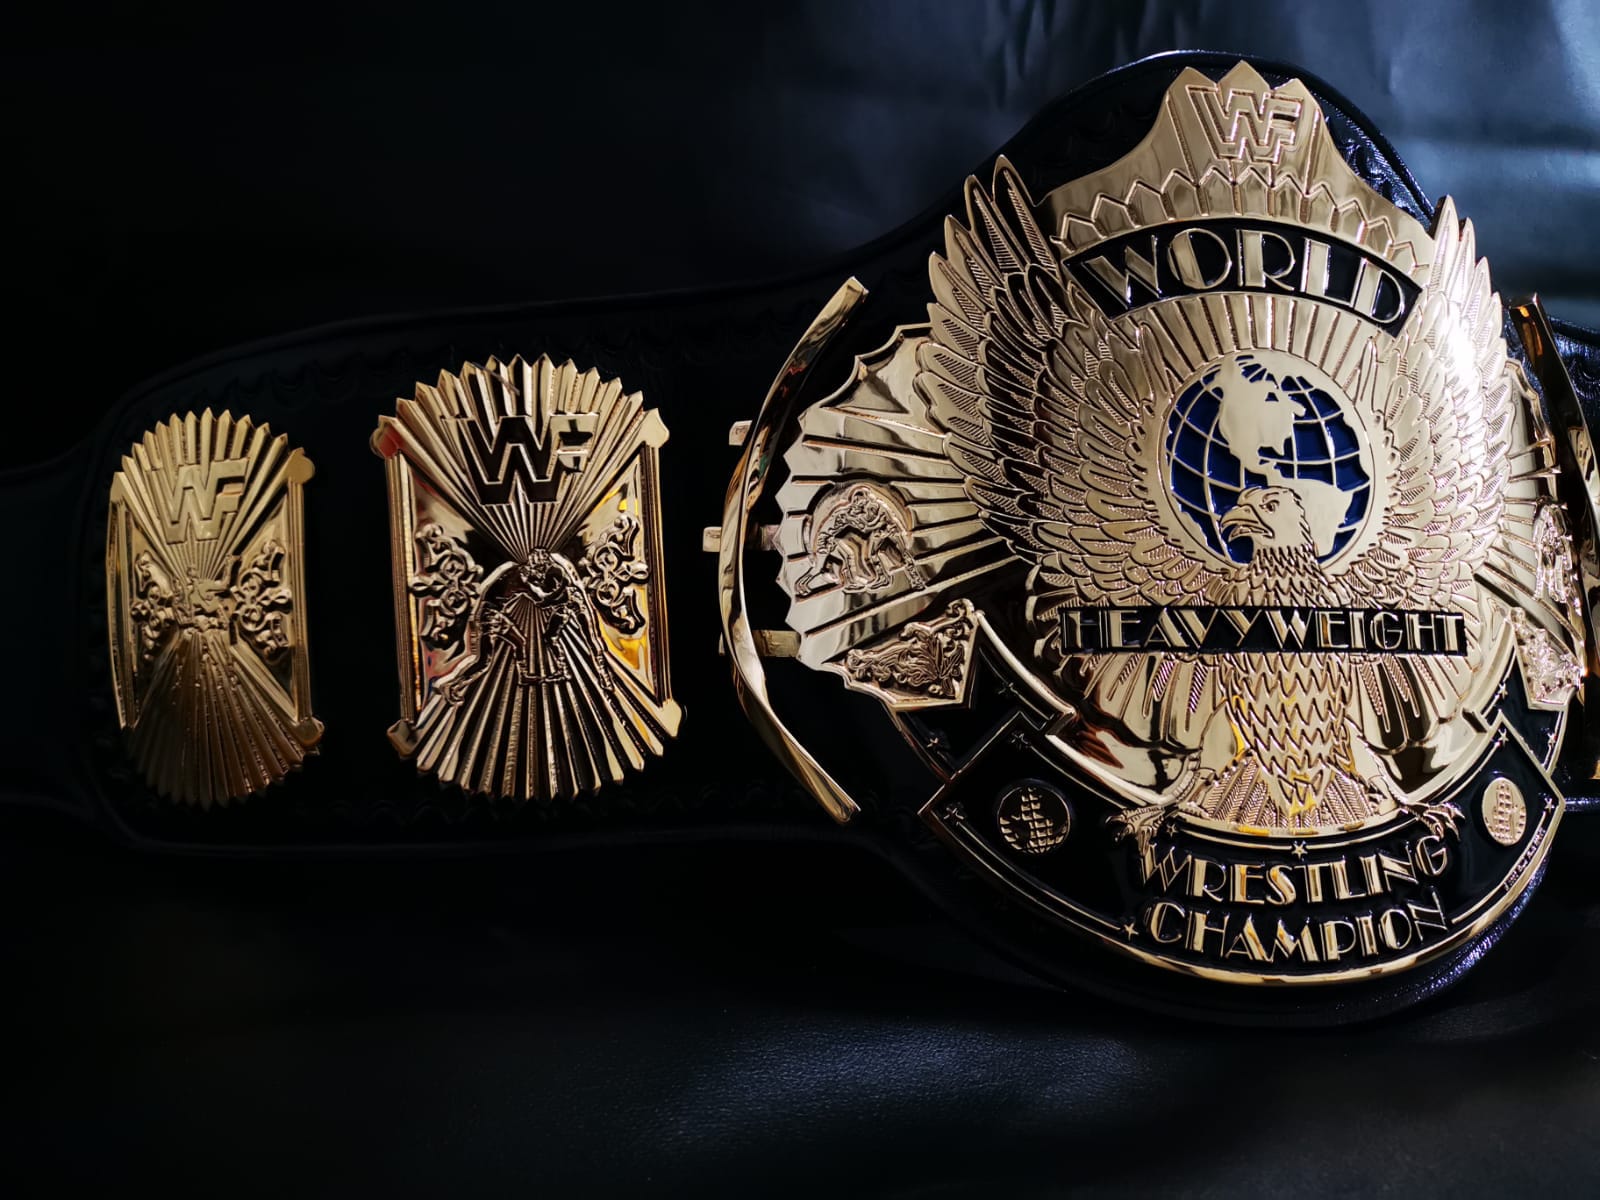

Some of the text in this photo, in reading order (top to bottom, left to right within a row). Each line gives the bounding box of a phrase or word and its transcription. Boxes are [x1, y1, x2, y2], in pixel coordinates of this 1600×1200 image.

[1081, 227, 1405, 324] WORLD
[1064, 609, 1465, 655] HEAVYWEIGHT
[1139, 835, 1448, 905] WRESTLING
[1143, 891, 1447, 963] CHAMPION
